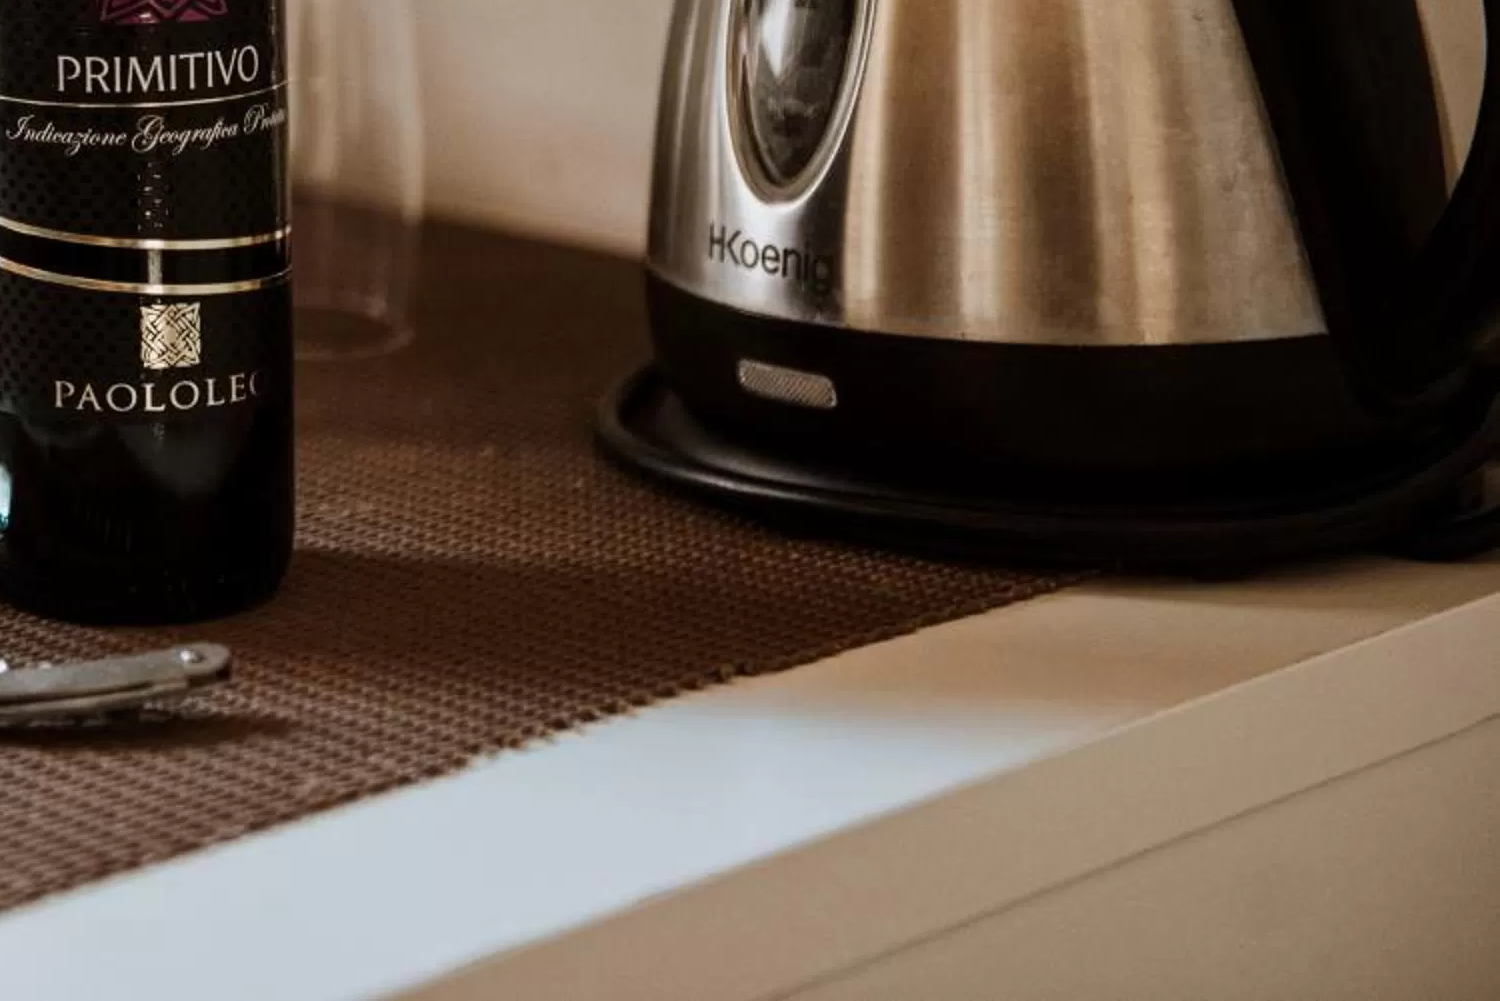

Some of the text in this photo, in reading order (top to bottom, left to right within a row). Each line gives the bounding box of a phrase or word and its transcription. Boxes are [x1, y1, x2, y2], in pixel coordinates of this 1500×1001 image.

[56, 44, 260, 94] PRIMITIVO
[5, 113, 127, 157] Indicazione
[131, 113, 240, 157] Geografica
